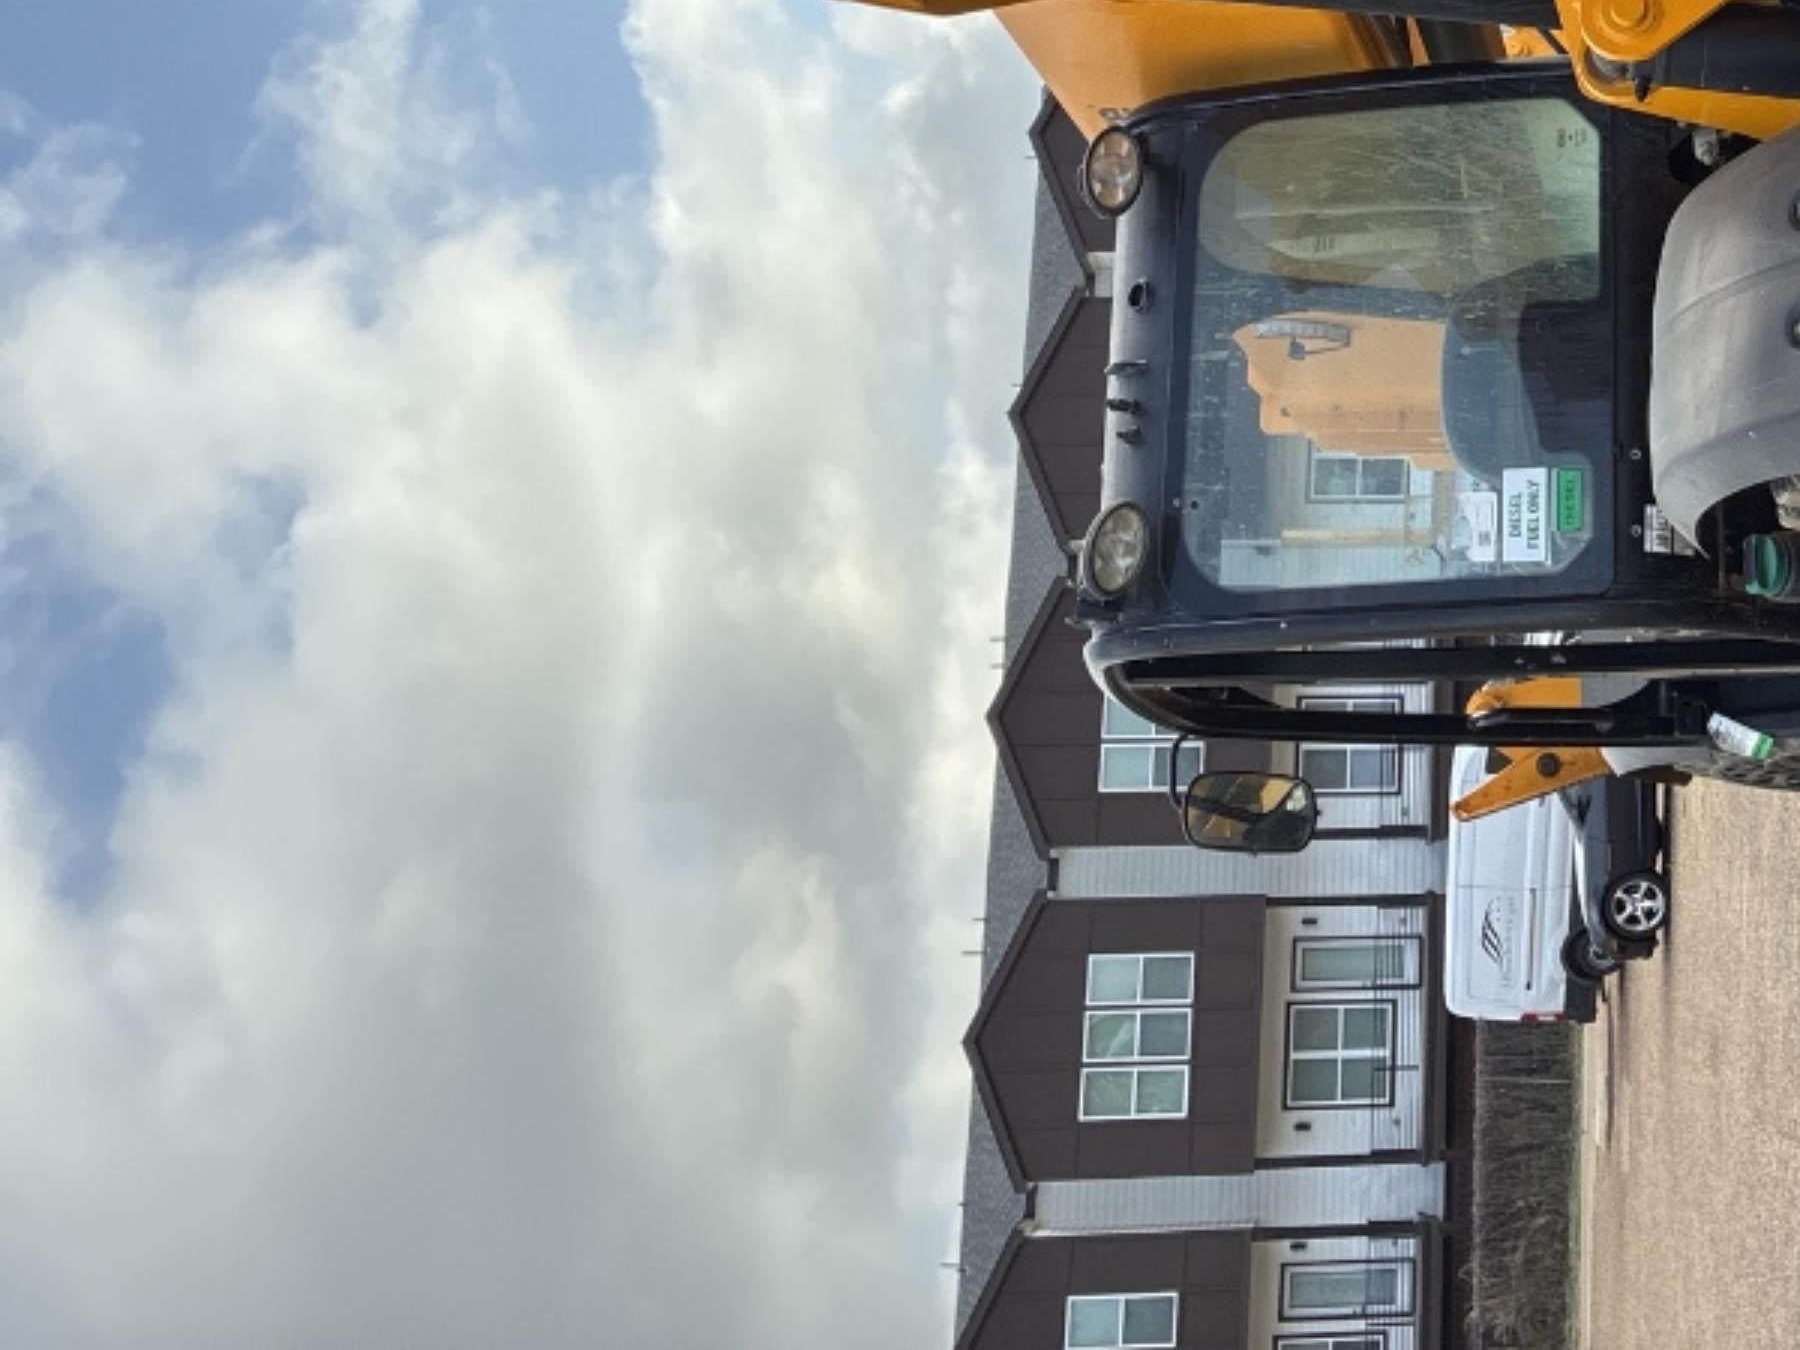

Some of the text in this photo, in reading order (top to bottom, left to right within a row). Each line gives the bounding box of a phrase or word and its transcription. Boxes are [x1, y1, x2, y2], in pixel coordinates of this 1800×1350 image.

[1508, 492, 1522, 538] DIESEL
[1526, 479, 1540, 550] FUEL ONLY
